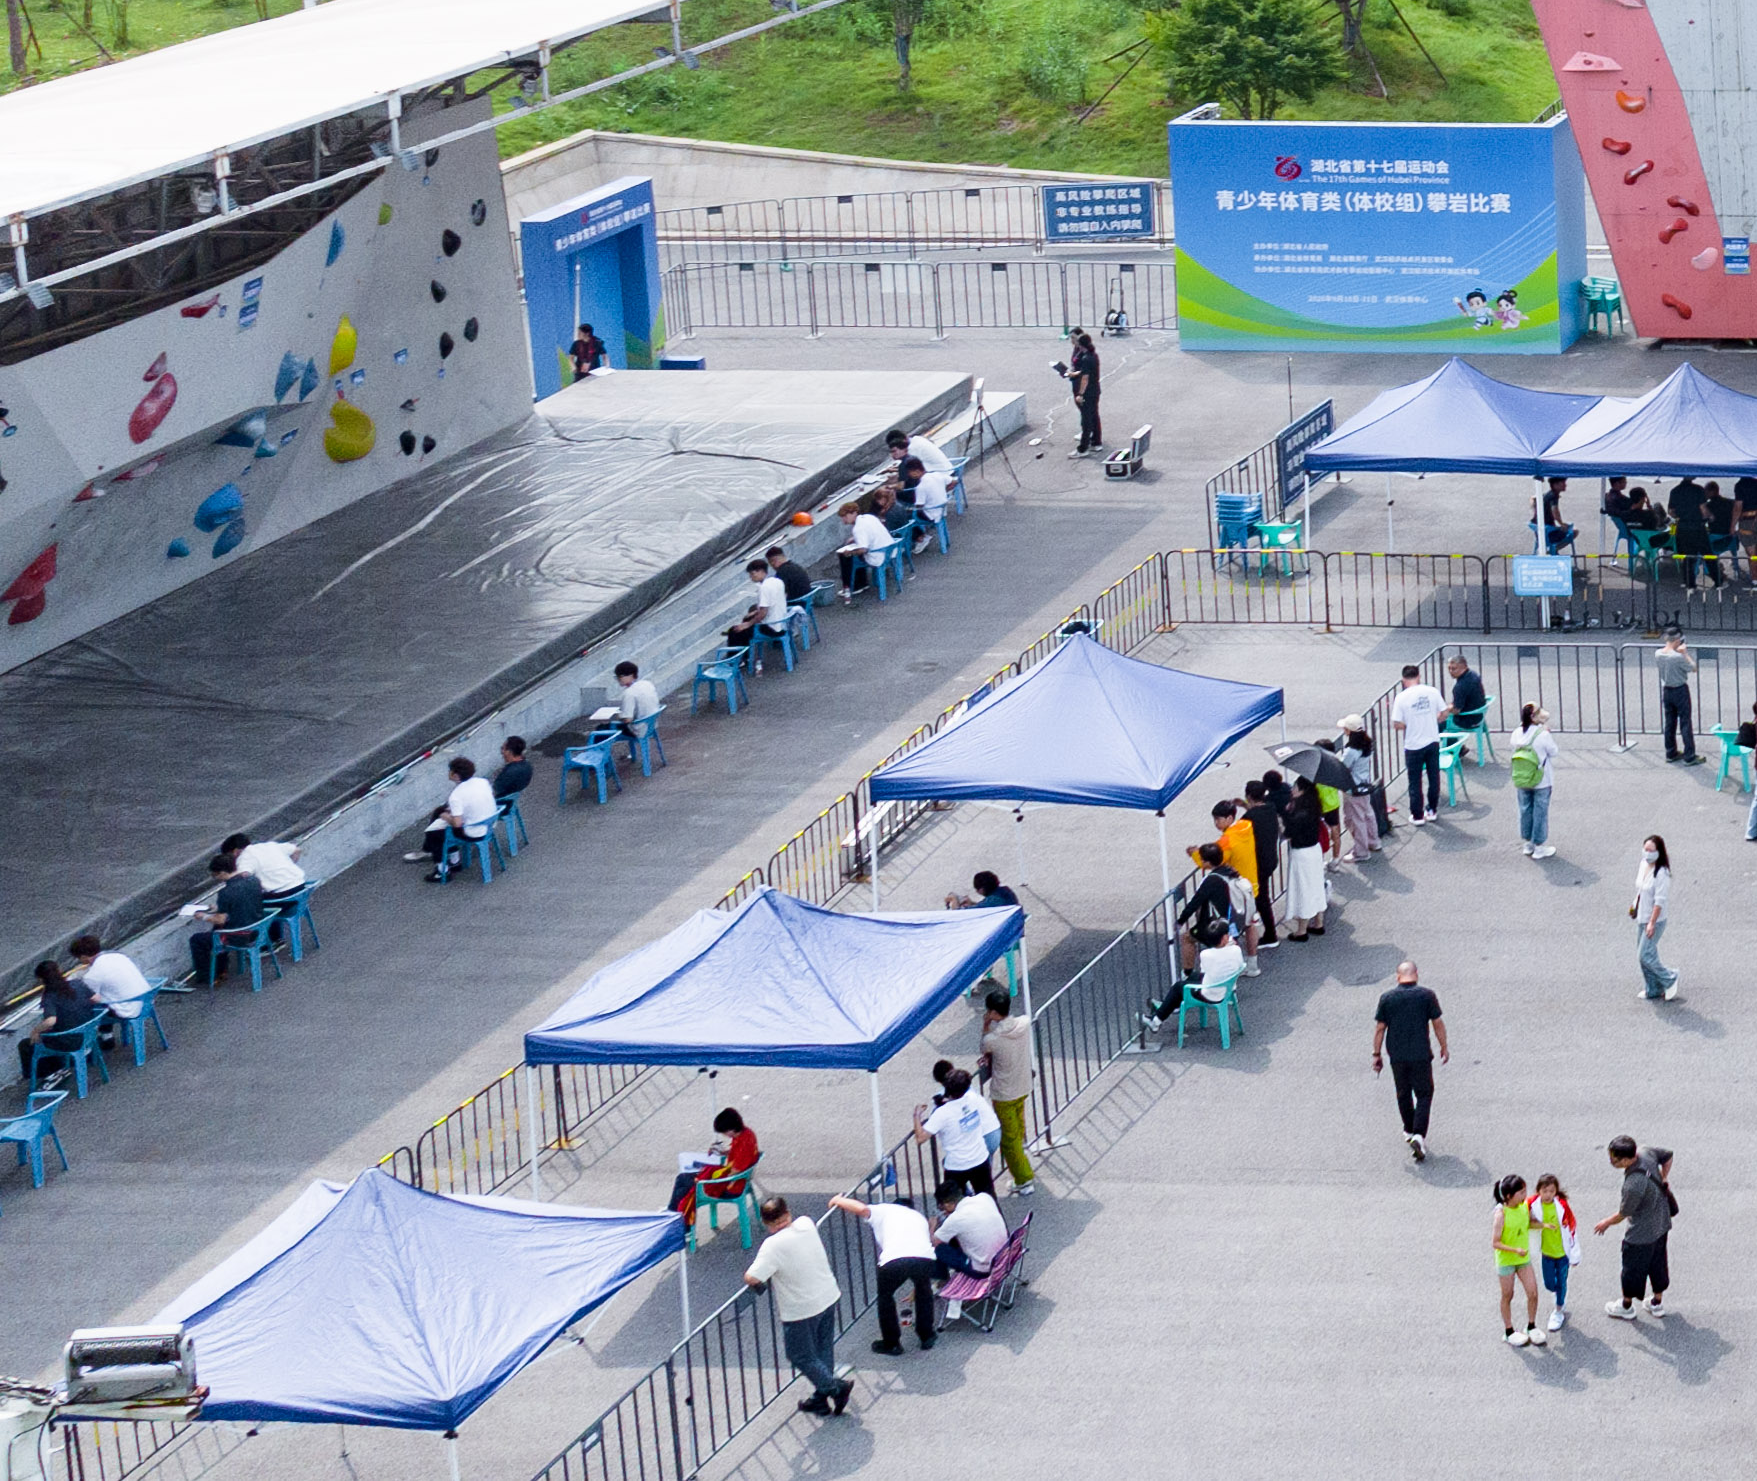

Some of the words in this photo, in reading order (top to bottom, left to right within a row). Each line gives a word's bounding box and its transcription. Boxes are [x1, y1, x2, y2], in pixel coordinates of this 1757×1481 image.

[1311, 159, 1450, 174] 湖北省第十七届运动会
[1312, 175, 1328, 184] The
[1329, 175, 1347, 184] 17th
[1349, 175, 1376, 184] Games
[1377, 175, 1387, 184] of
[1388, 175, 1412, 184] Hubei
[1413, 175, 1450, 184] Province
